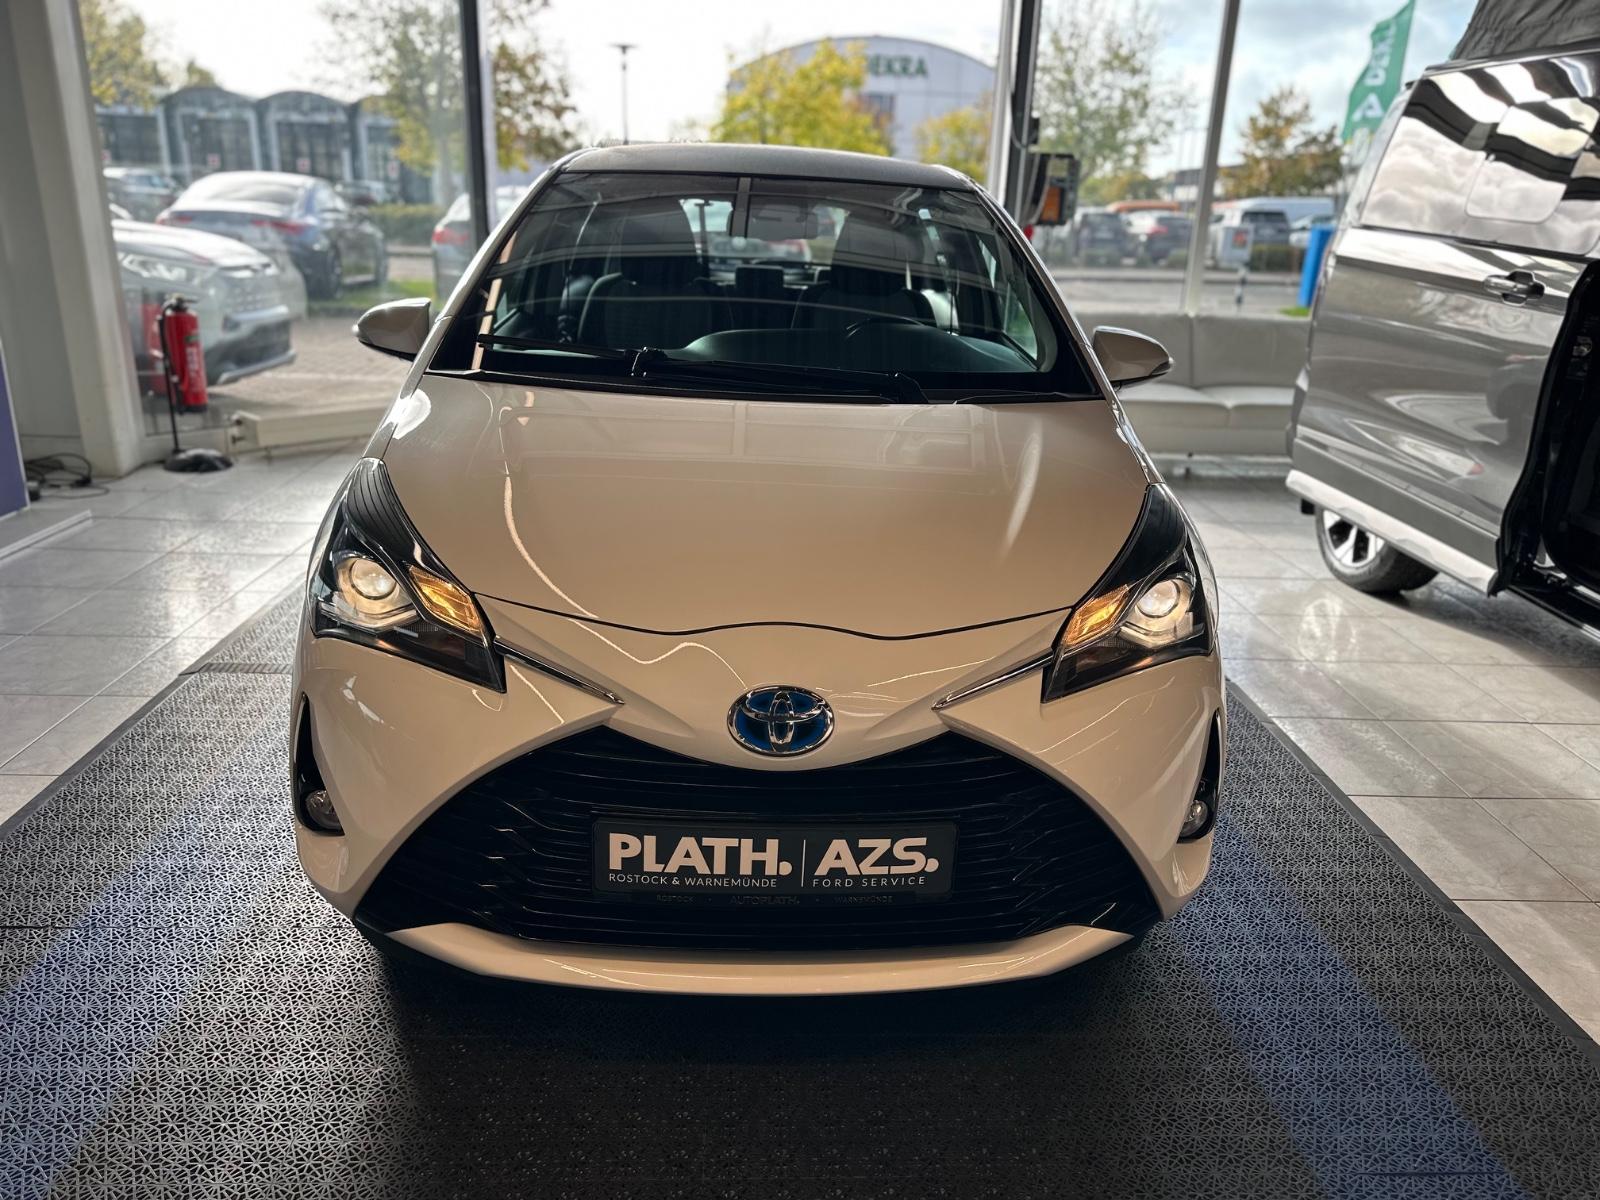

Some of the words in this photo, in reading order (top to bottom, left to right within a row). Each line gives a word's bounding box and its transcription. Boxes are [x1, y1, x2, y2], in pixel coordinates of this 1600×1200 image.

[609, 832, 793, 876] PLATH.
[814, 837, 940, 876] AZS.
[609, 873, 668, 885] ROSTOCK
[672, 877, 680, 885] &
[684, 876, 777, 888] WARNEMÜNDE
[813, 878, 853, 888] FORD
[862, 876, 926, 887] SERVICE
